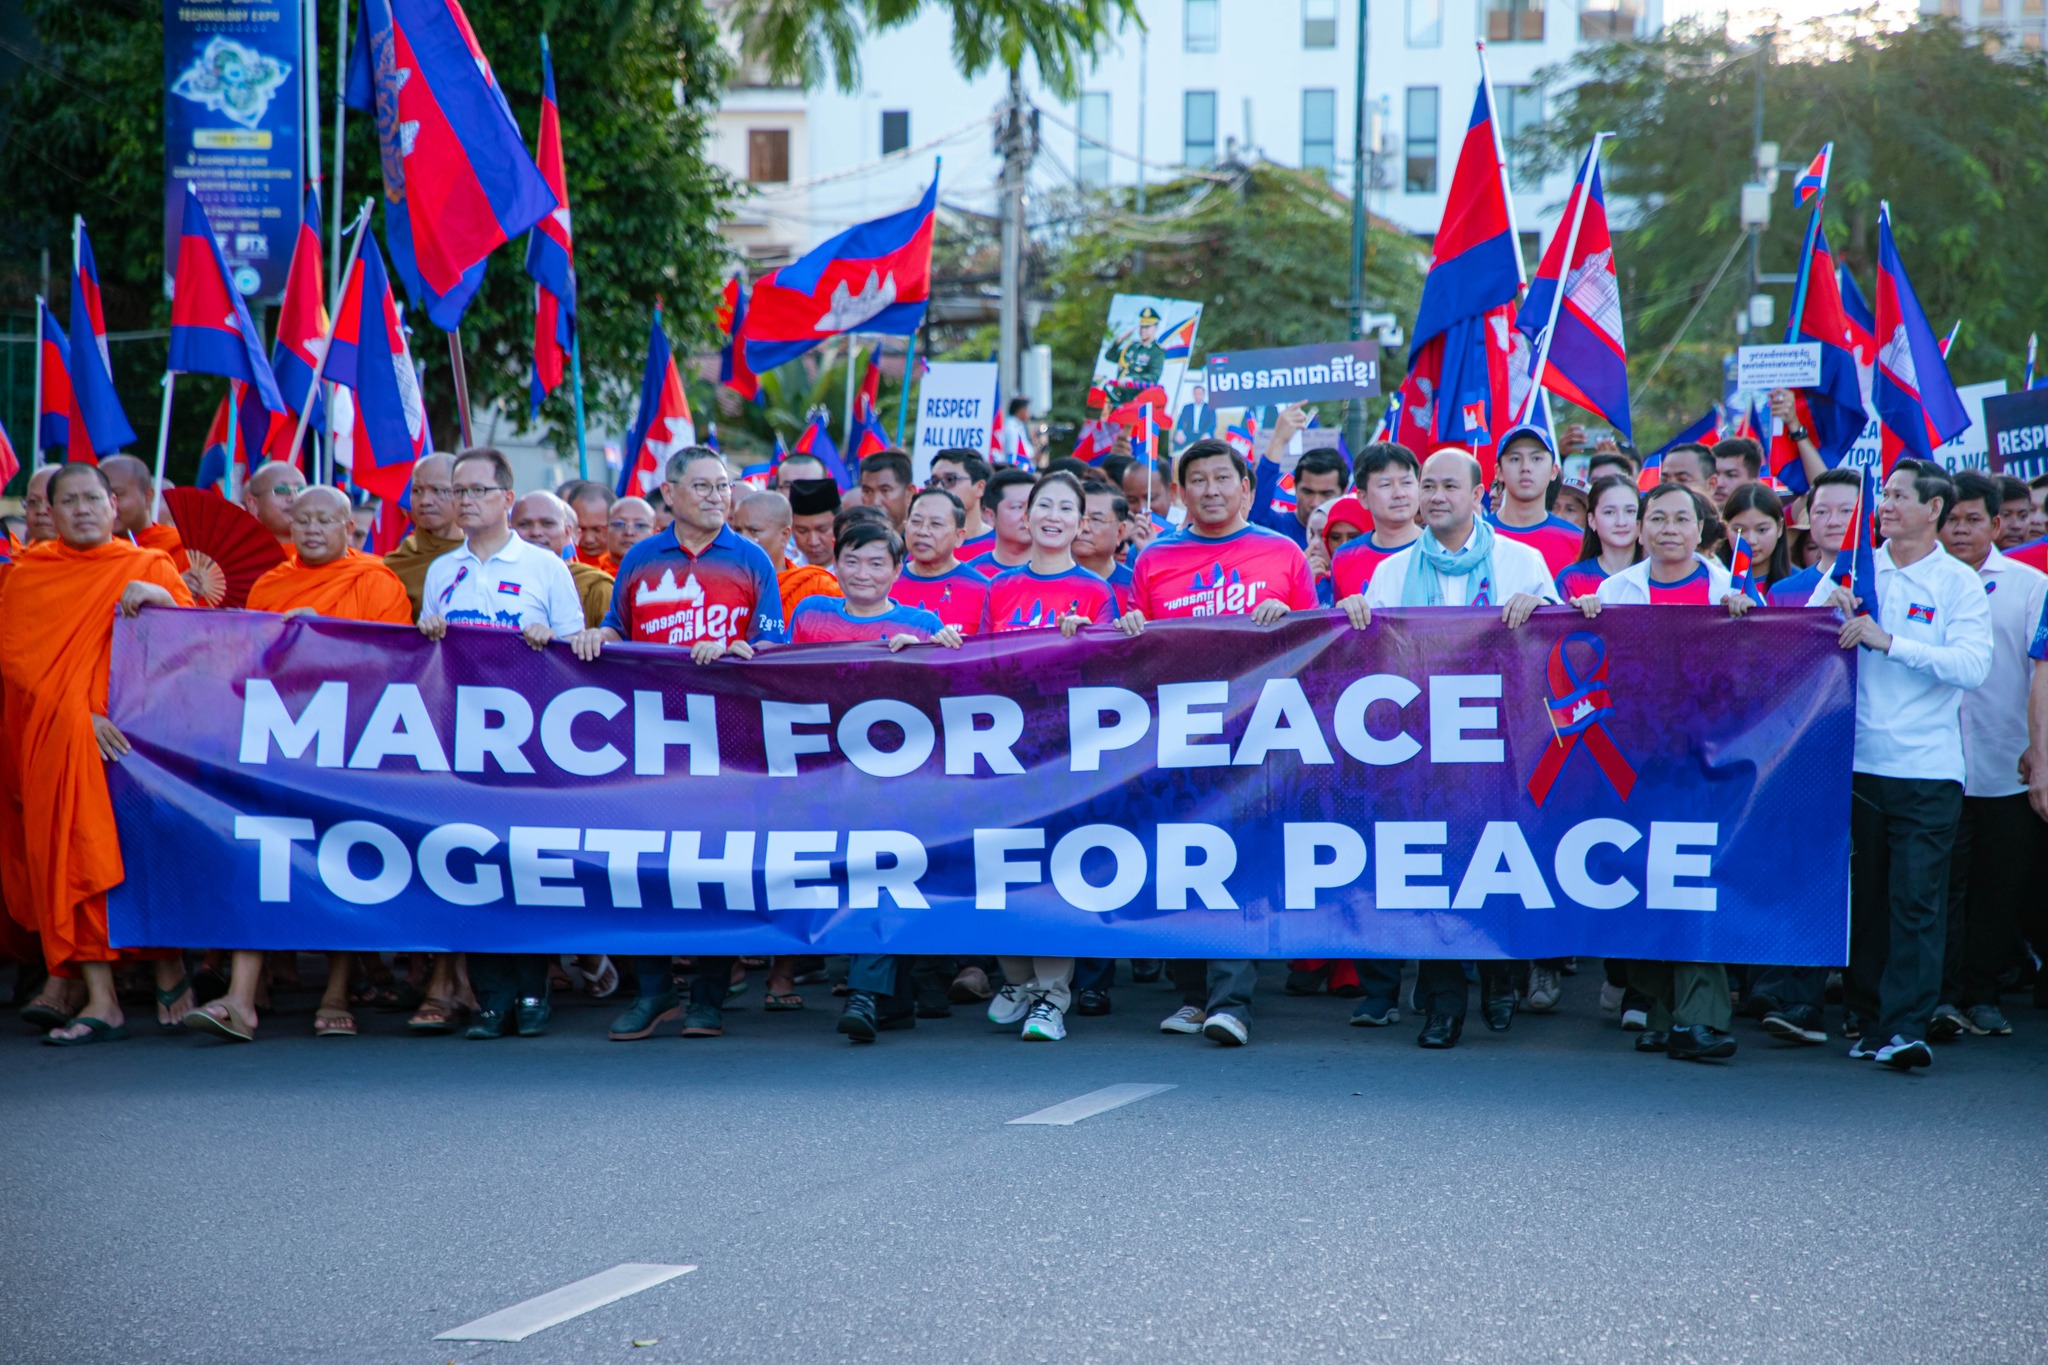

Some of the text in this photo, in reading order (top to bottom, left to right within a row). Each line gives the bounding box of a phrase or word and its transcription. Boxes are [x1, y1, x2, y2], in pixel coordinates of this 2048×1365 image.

[926, 399, 981, 418] RESPECT
[923, 427, 984, 447] ALL LIVES
[1961, 451, 1989, 472] WA
[239, 674, 1505, 778] MARCH FOR PEACE
[234, 815, 1719, 913] TOGETHER FOR PEACE
